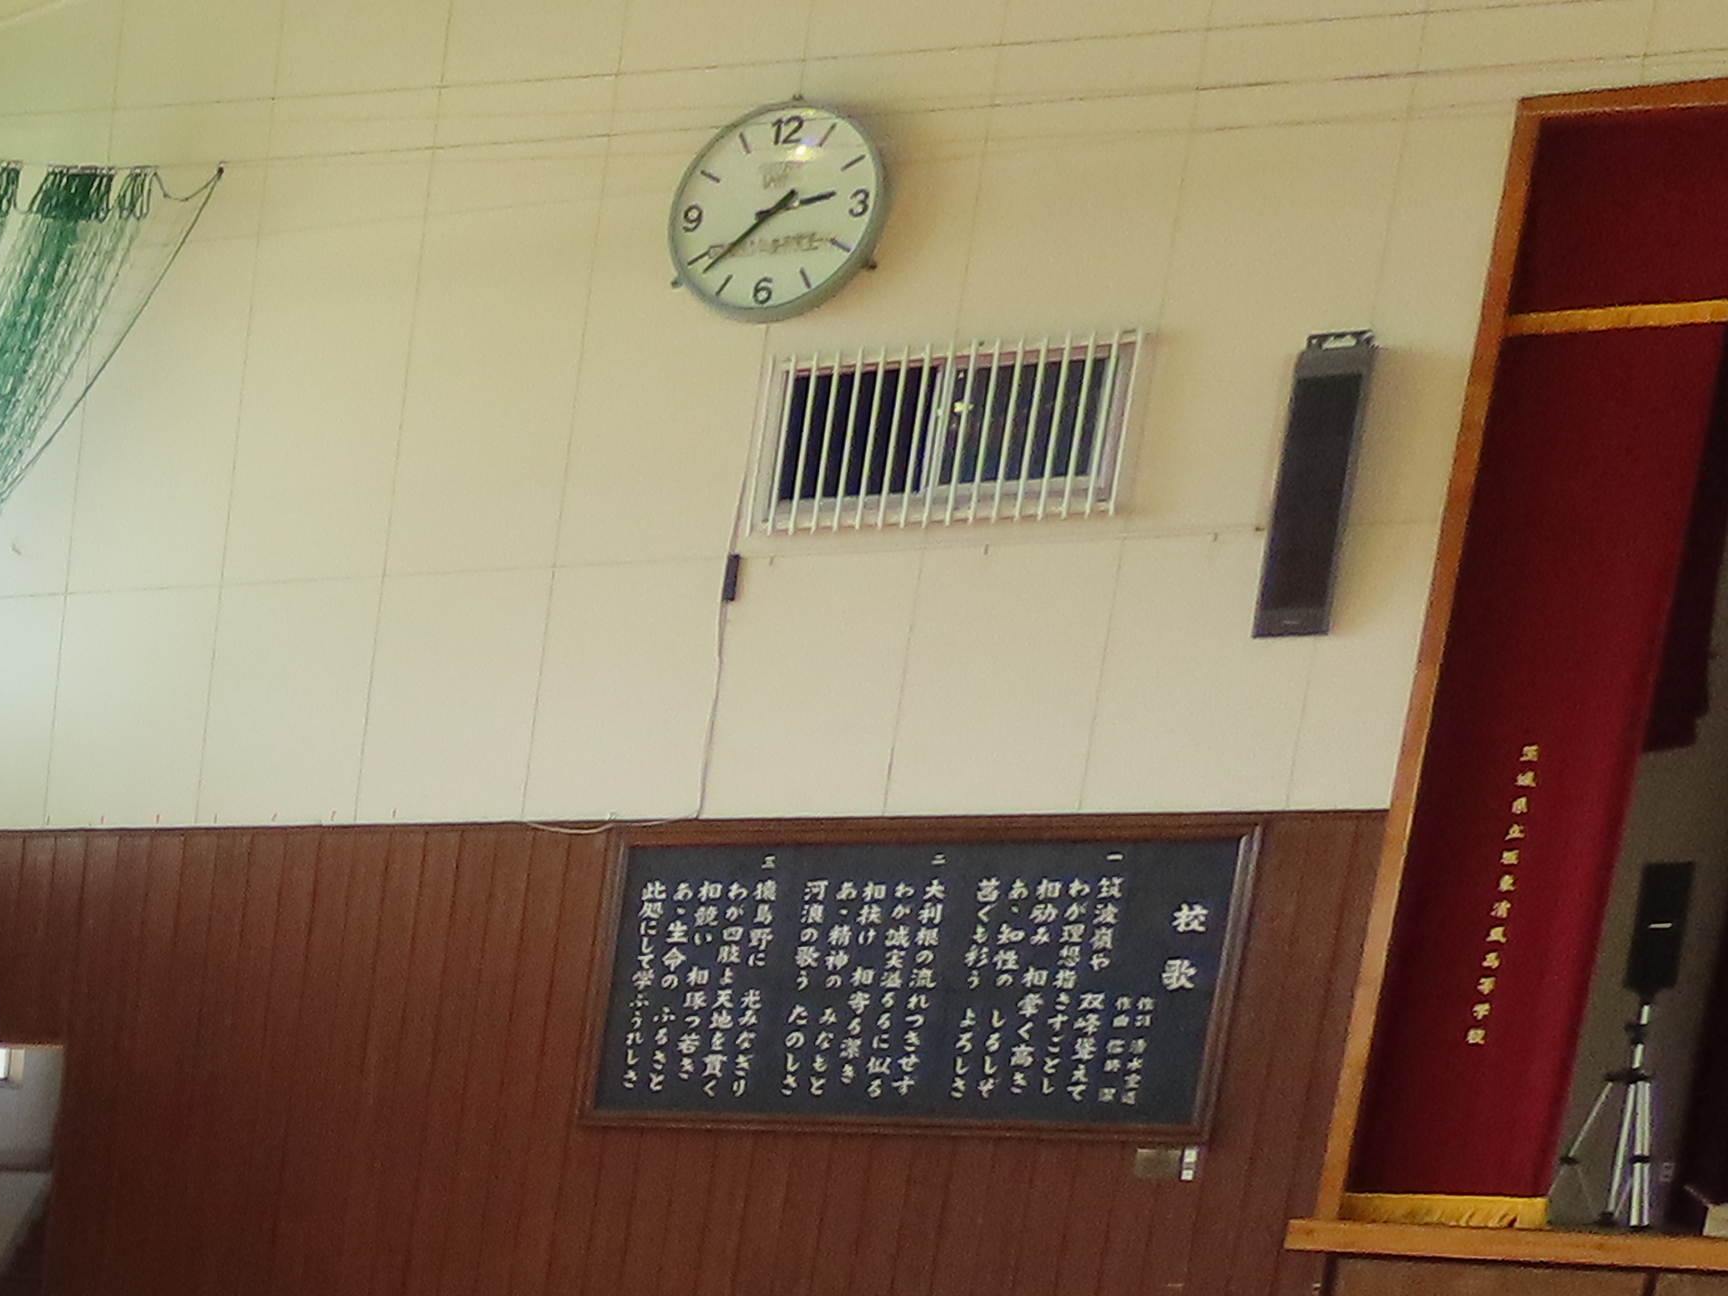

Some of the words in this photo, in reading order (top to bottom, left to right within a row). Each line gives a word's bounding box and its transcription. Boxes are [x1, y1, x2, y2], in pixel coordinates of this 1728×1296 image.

[772, 115, 805, 146] 12
[682, 203, 704, 233] 9
[848, 188, 870, 218] 3
[752, 277, 773, 305] 6
[1088, 876, 1124, 971] 筑波嶺や
[1161, 902, 1211, 991] 校歌
[649, 1006, 676, 1092] ふるさと
[781, 1004, 809, 1096] たのしさ
[810, 1007, 838, 1095] みなもと
